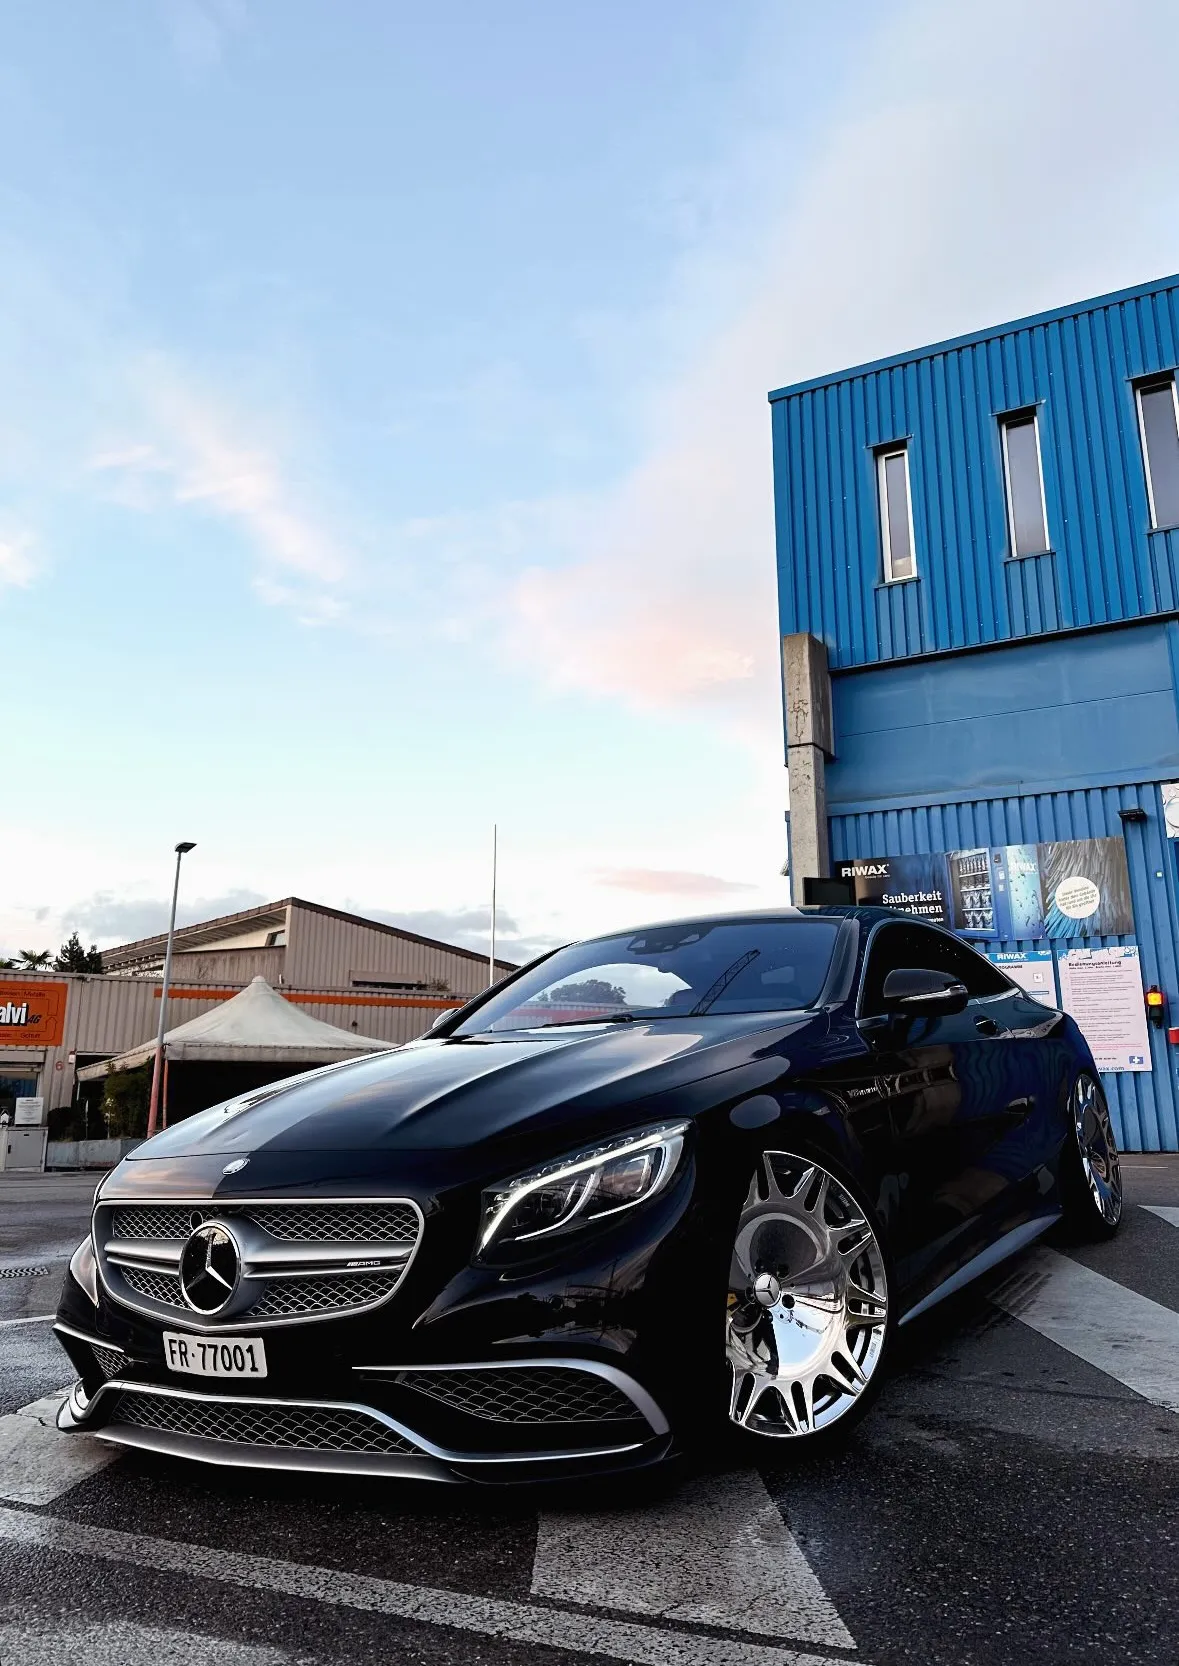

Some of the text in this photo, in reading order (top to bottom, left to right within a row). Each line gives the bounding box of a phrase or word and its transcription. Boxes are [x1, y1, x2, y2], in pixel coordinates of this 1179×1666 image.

[841, 864, 888, 877] RIWAX
[882, 890, 943, 904] Sauberkeit
[889, 904, 943, 915] nehmen
[27, 1014, 42, 1024] AG
